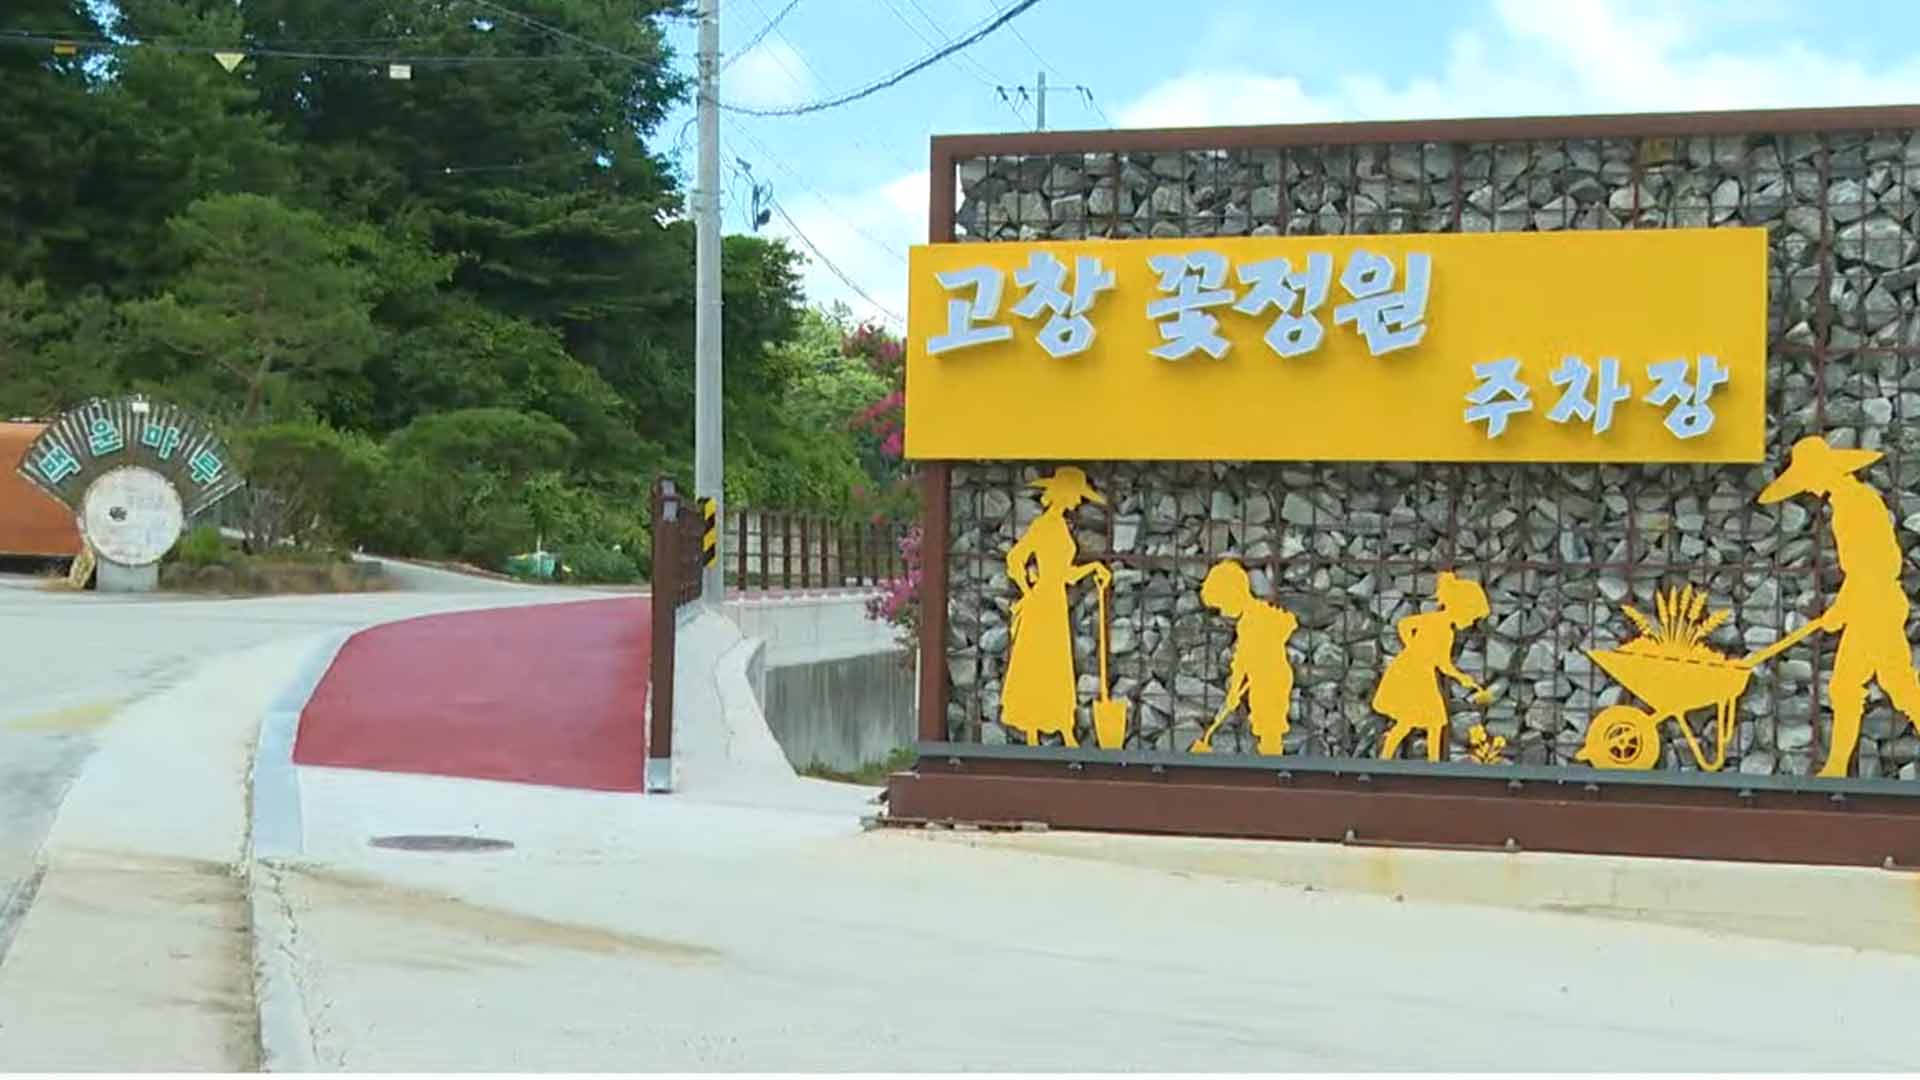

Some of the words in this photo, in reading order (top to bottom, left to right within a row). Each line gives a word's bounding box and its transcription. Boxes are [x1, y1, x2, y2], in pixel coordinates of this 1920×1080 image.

[926, 252, 1116, 358] 고창
[1147, 250, 1434, 359] 꽃정원
[1464, 354, 1730, 440] 주차장
